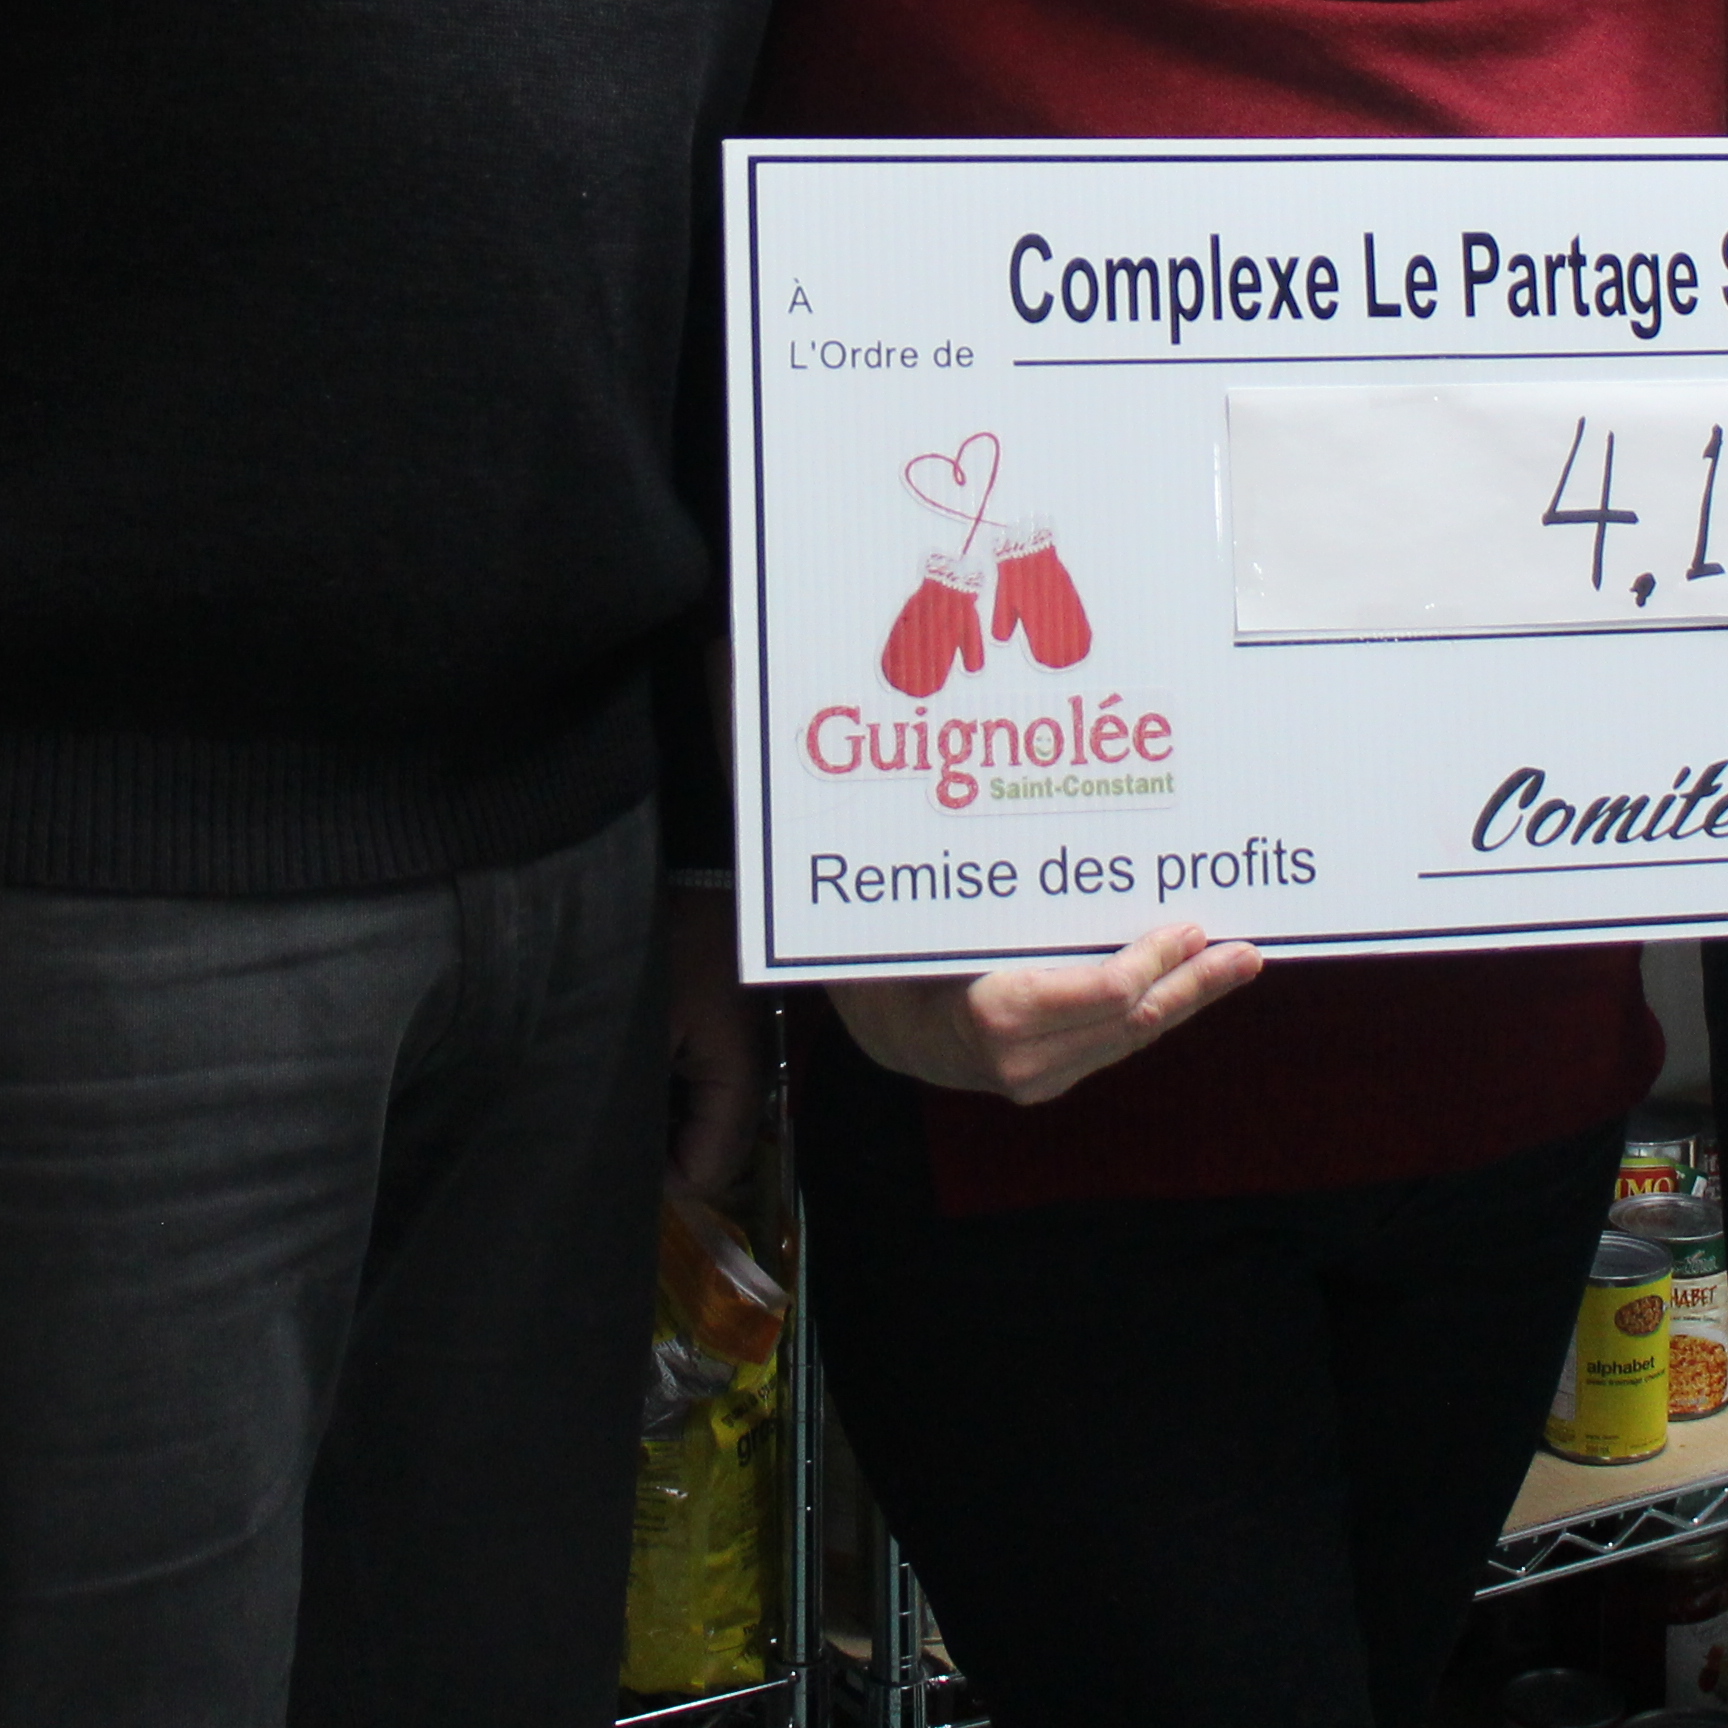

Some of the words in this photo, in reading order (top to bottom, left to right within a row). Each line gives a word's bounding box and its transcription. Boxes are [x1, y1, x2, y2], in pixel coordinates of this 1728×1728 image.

[788, 276, 813, 316] À
[1009, 231, 1340, 346] Complexe
[1364, 231, 1439, 320] Le
[1460, 230, 1700, 341] Partage
[789, 339, 919, 370] L'Ordre
[933, 339, 975, 368] de
[805, 692, 1175, 810] Guignolée
[989, 773, 1175, 801] Saint-Constant
[810, 849, 1019, 906] Remise
[1038, 845, 1136, 897] des
[1156, 835, 1318, 904] profits
[1586, 1353, 1656, 1378] alphabet
